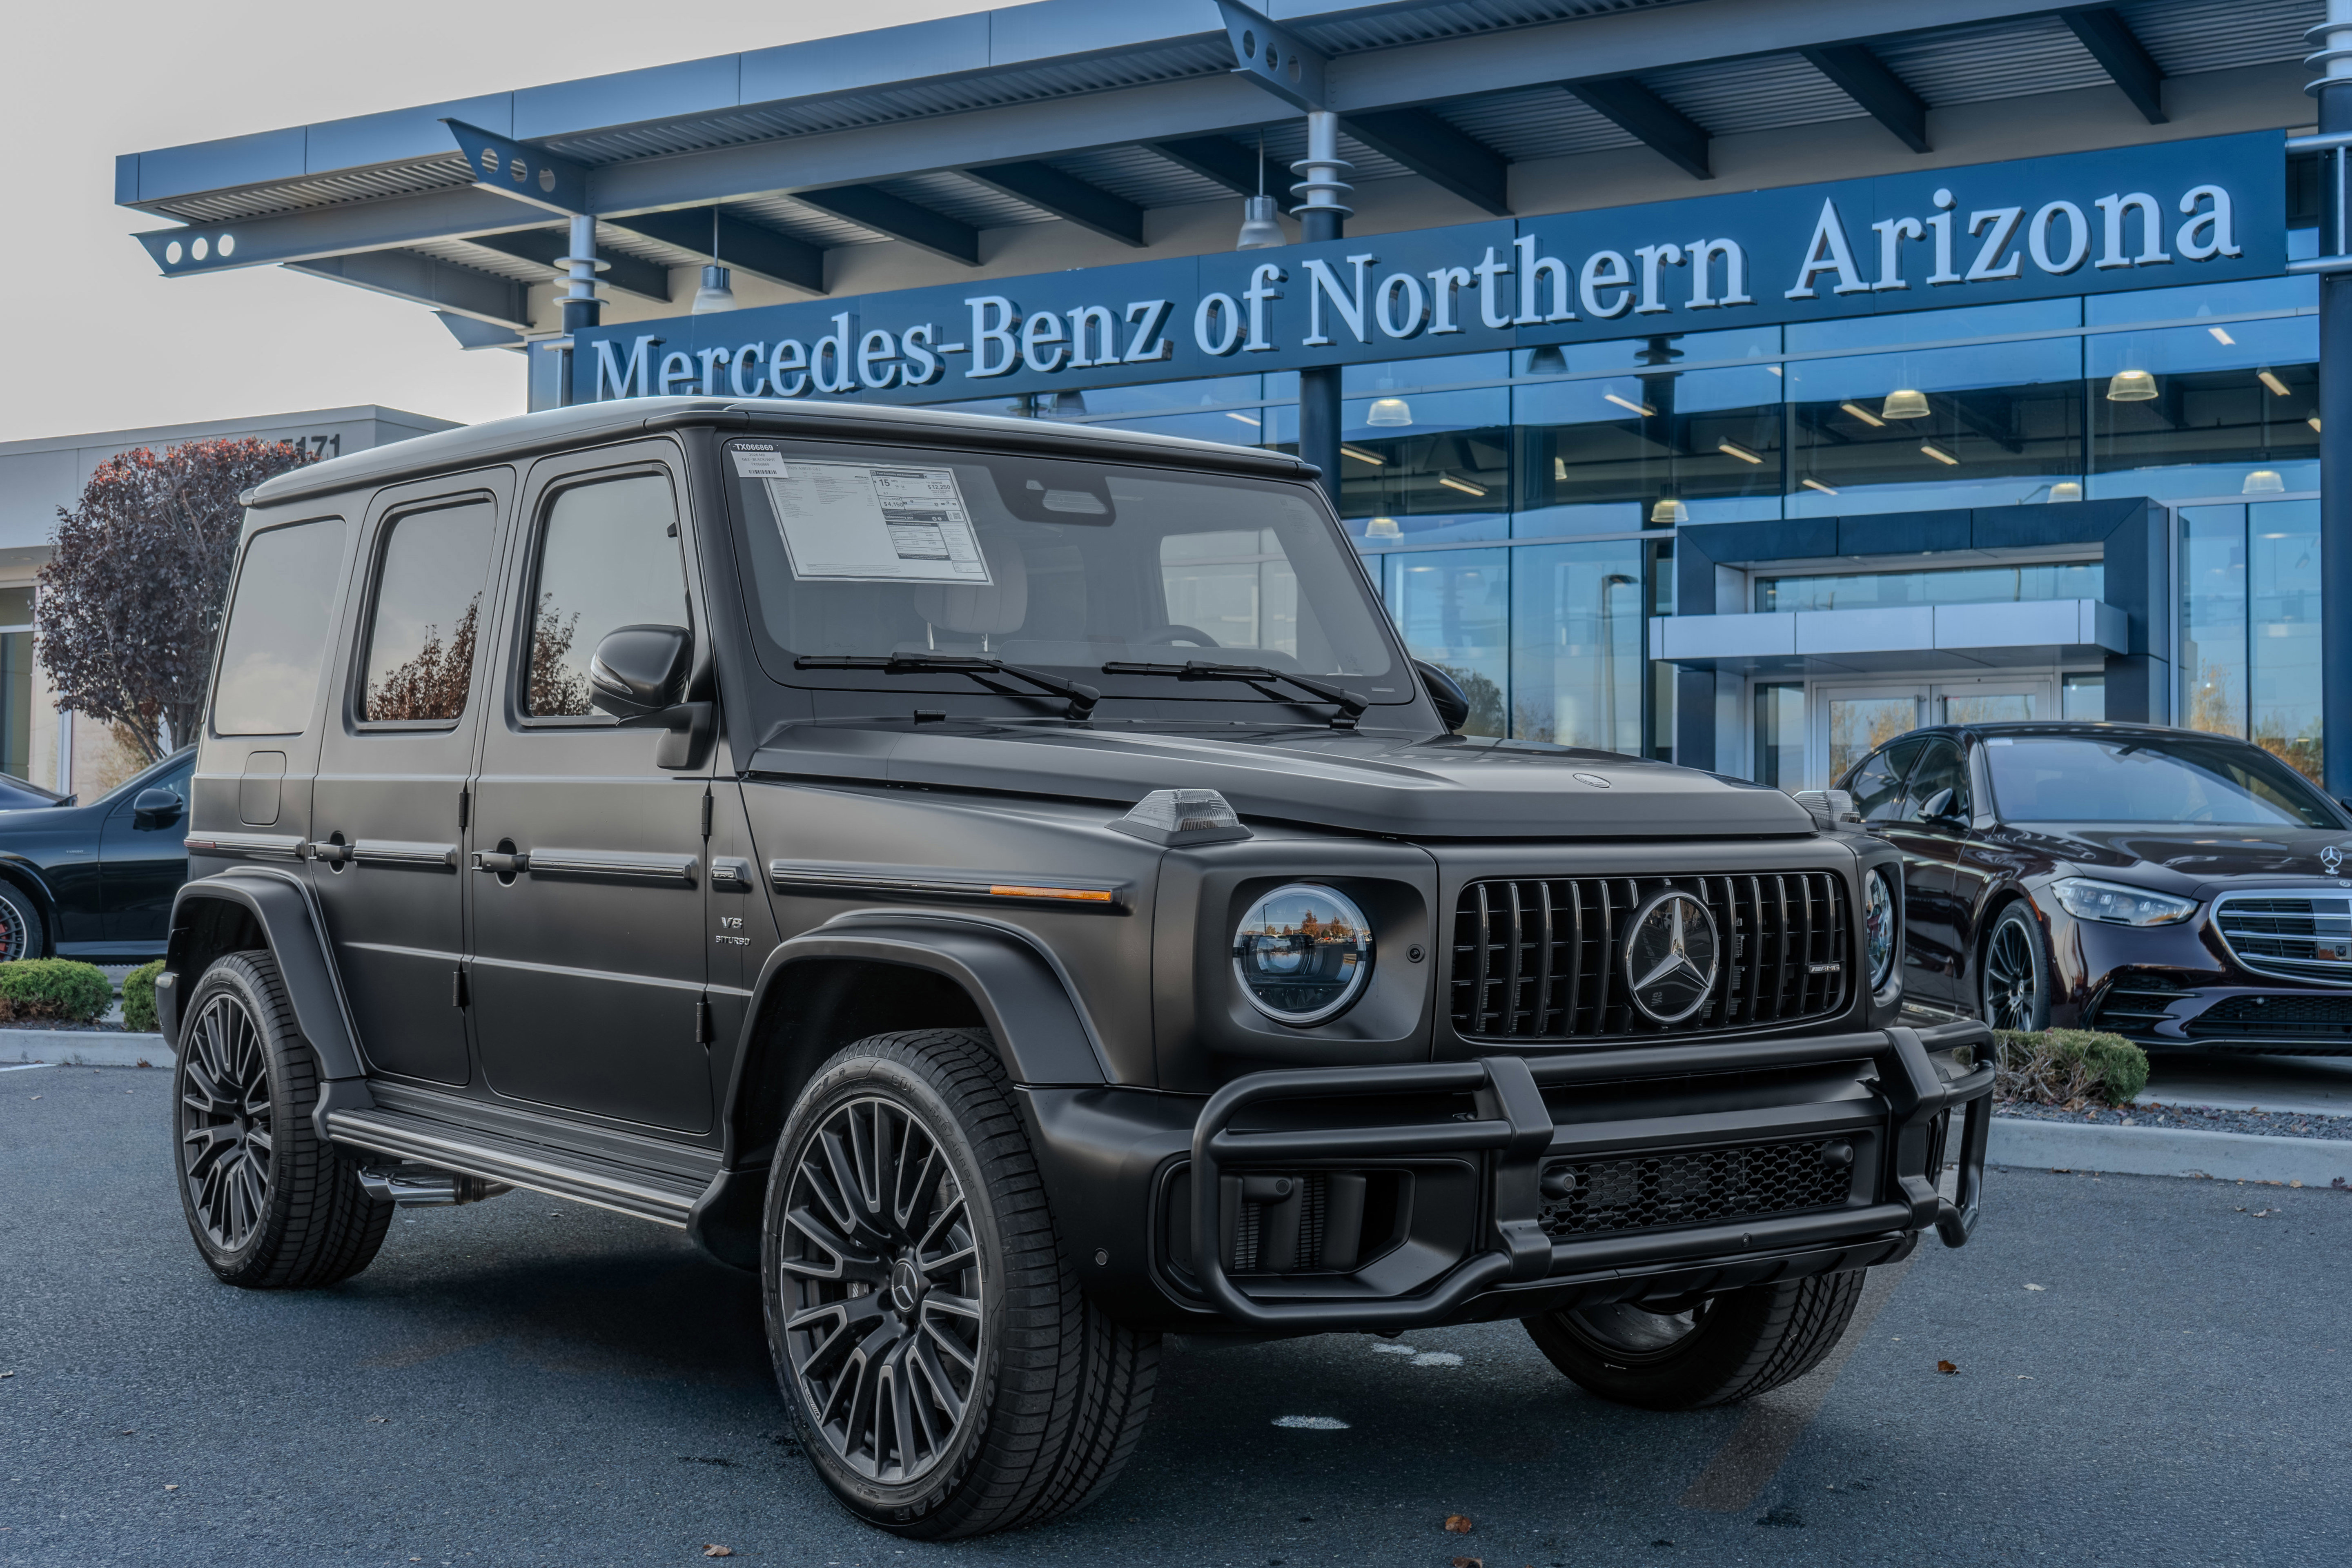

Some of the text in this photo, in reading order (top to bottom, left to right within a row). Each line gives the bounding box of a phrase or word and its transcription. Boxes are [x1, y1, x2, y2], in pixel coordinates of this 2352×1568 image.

[592, 185, 2243, 398] Mercedes-Benz of Northern Arizona
[721, 917, 743, 929] V8
[715, 935, 751, 946] BITURBO
[891, 1074, 916, 1096] SUV
[894, 1349, 999, 1521] GOODYEAR
